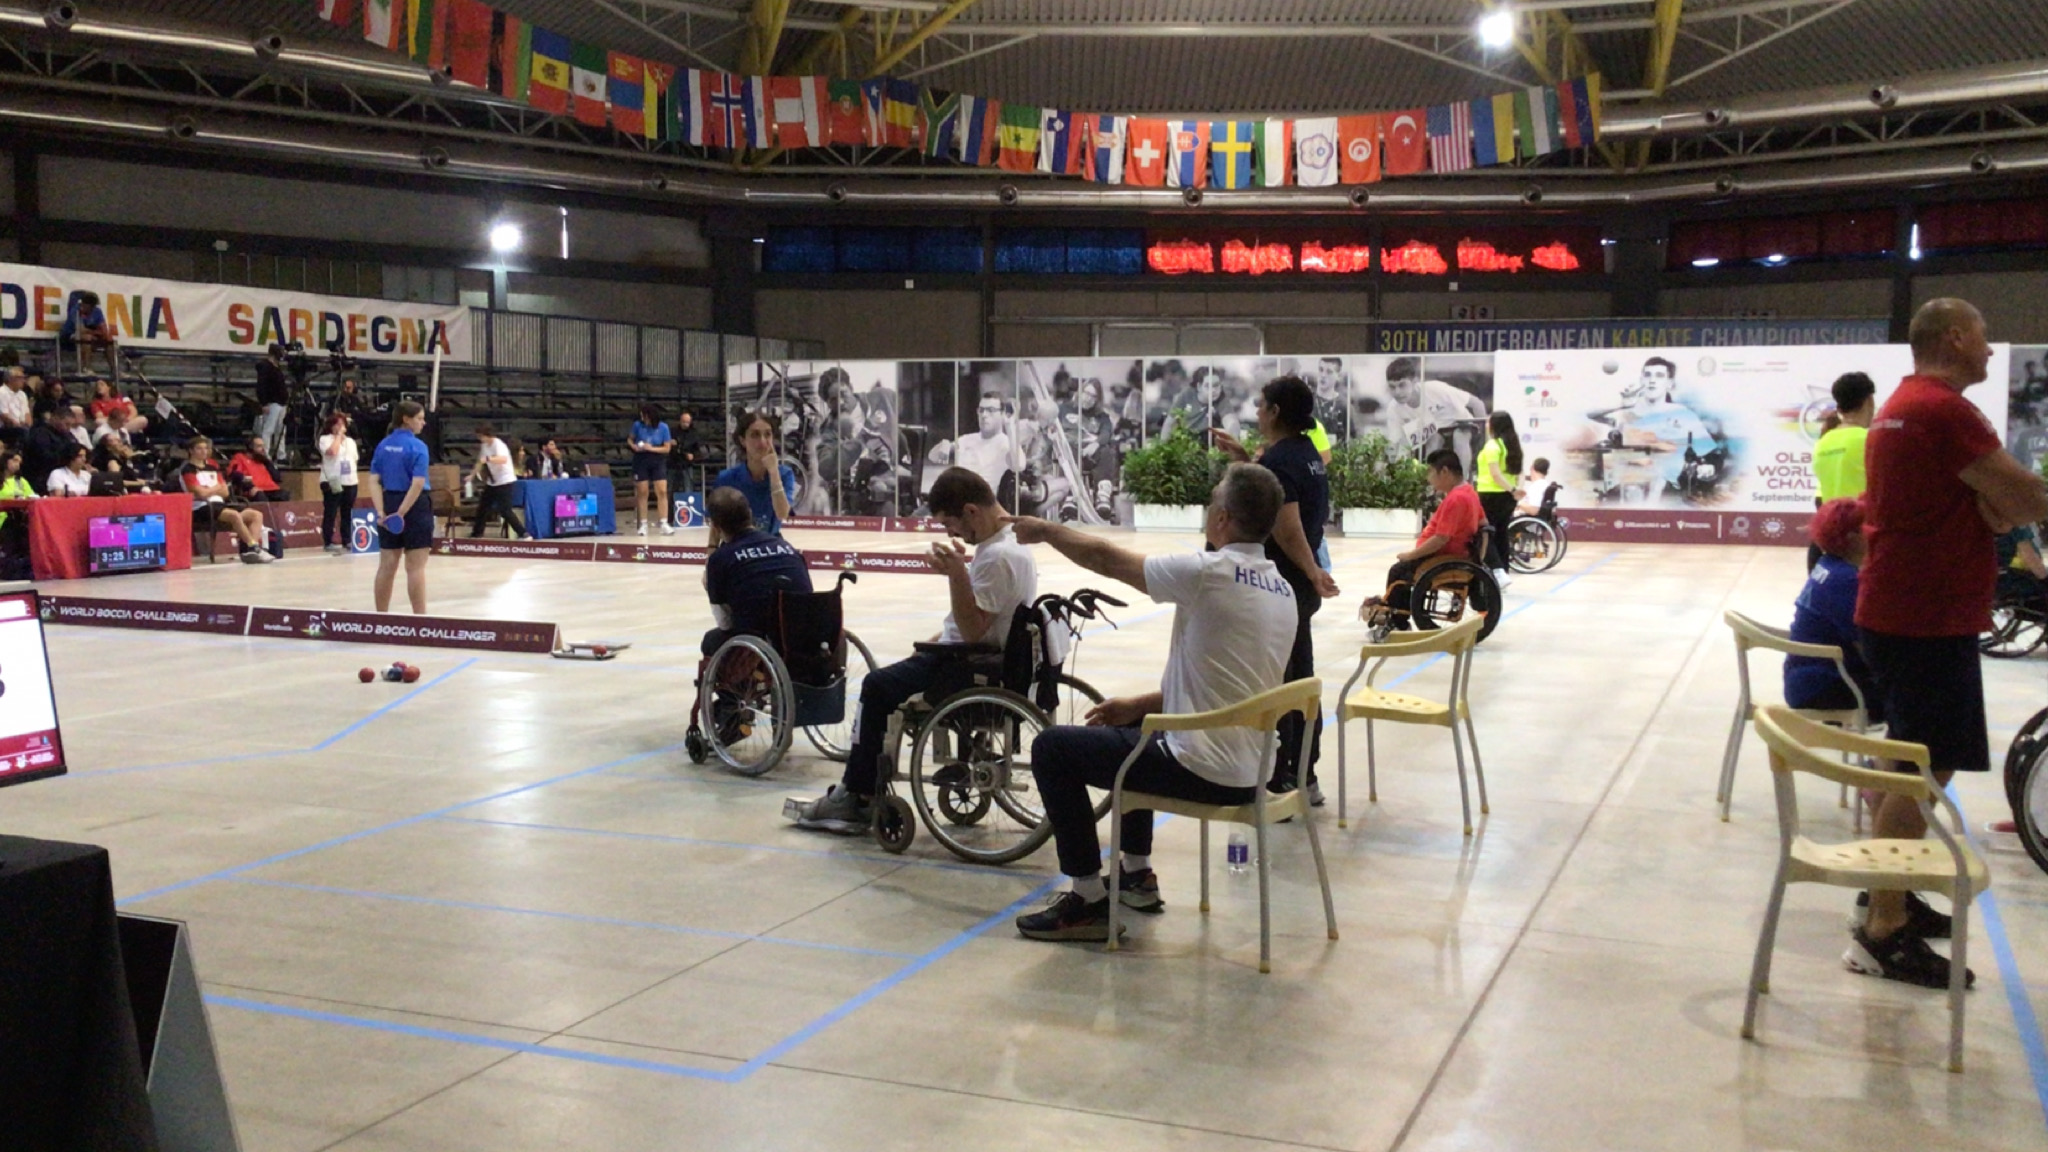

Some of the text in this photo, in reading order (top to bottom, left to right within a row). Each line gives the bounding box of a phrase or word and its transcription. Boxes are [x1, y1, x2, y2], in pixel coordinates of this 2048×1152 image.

[228, 303, 451, 354] SARDEGNA
[1381, 326, 1886, 352] 30TH MEDITERRANEAN KARATE CHAMPIONSHIPS
[1752, 491, 1813, 503] September
[680, 509, 689, 525] 5
[357, 529, 367, 548] 3
[101, 550, 125, 562] 3:25
[456, 544, 482, 552] WORLD
[652, 551, 681, 559] WORLD
[734, 545, 794, 561] HELLAS
[861, 558, 893, 567] WORLD
[894, 559, 925, 568] BOCCIA
[1235, 565, 1291, 597] HELLAS
[60, 606, 199, 623] WORLD BOCCIA CHALLENGER
[331, 621, 373, 633] WORLD
[375, 624, 416, 637] BOCCIA
[419, 627, 496, 642] CHALLENGER
